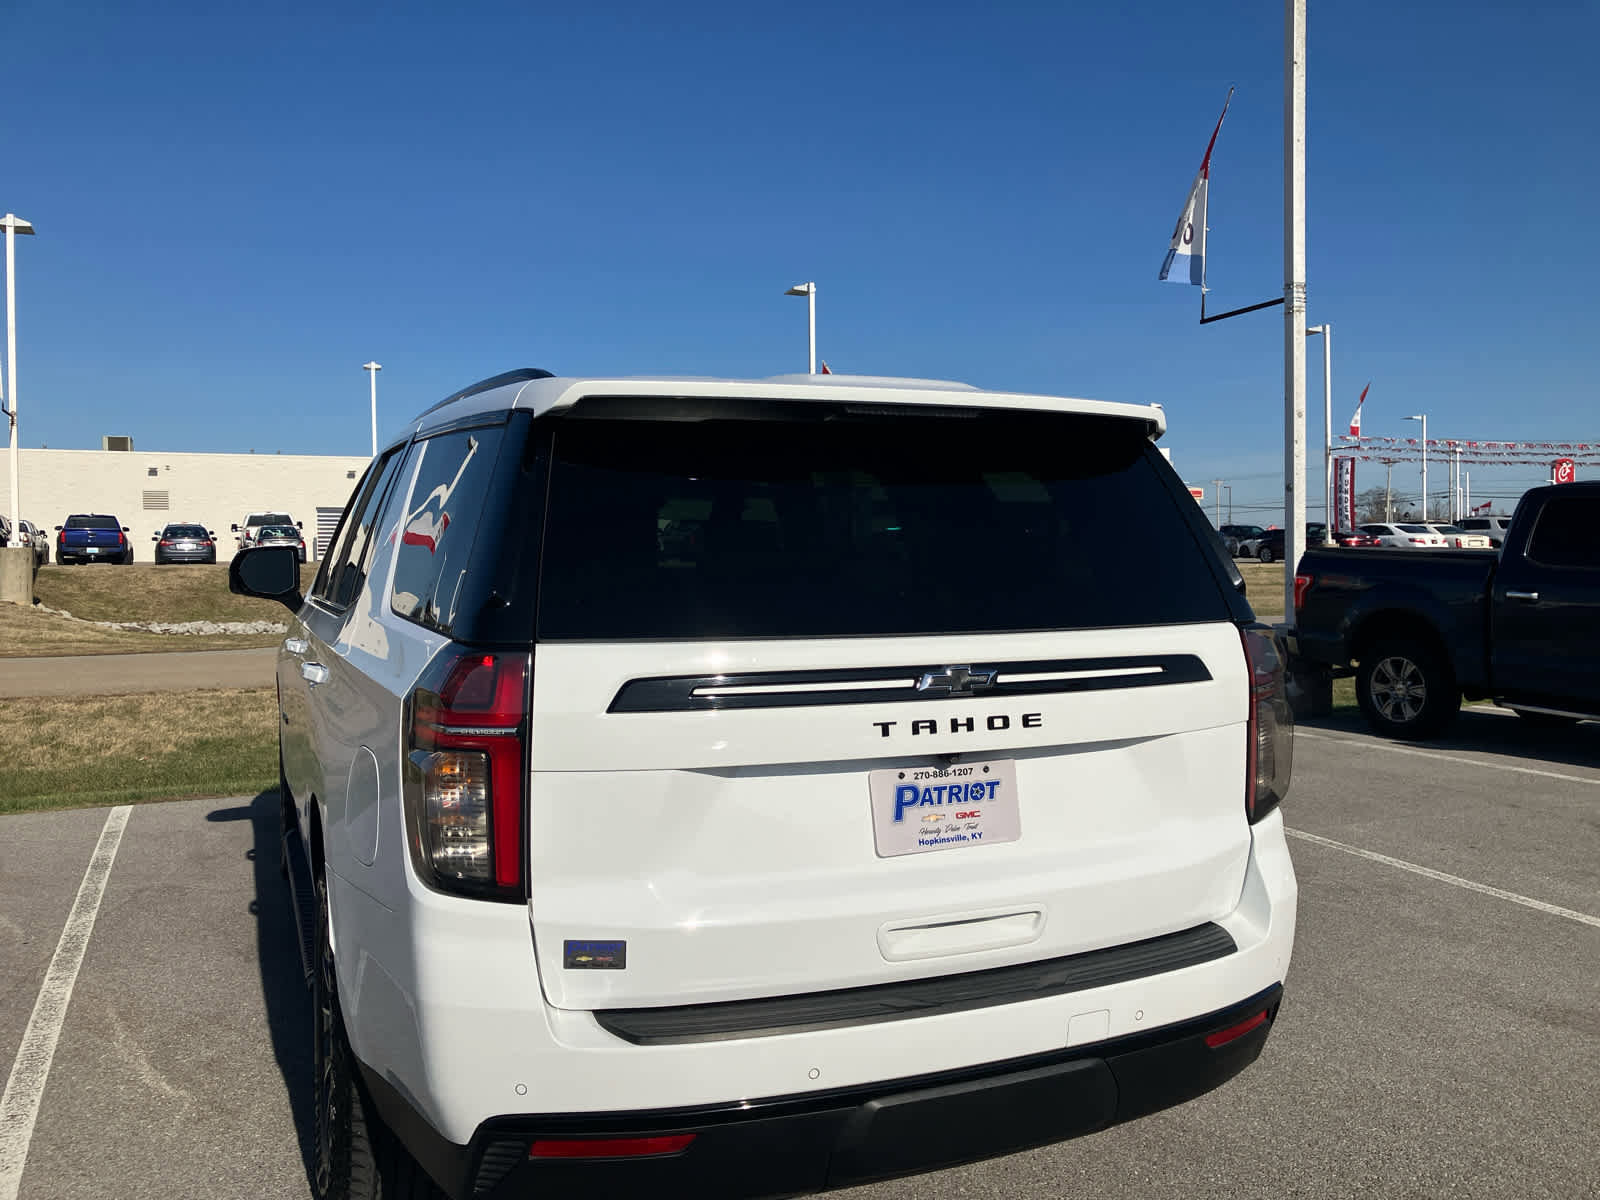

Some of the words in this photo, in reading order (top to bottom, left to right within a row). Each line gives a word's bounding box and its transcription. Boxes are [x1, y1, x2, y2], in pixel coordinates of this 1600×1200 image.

[872, 713, 1043, 738] TAHOE
[913, 768, 974, 779] 270-886-1207
[894, 780, 1000, 823] PATRIOT
[955, 810, 981, 820] GMC
[918, 833, 970, 847] Hopkinsville,
[971, 831, 983, 841] KY
